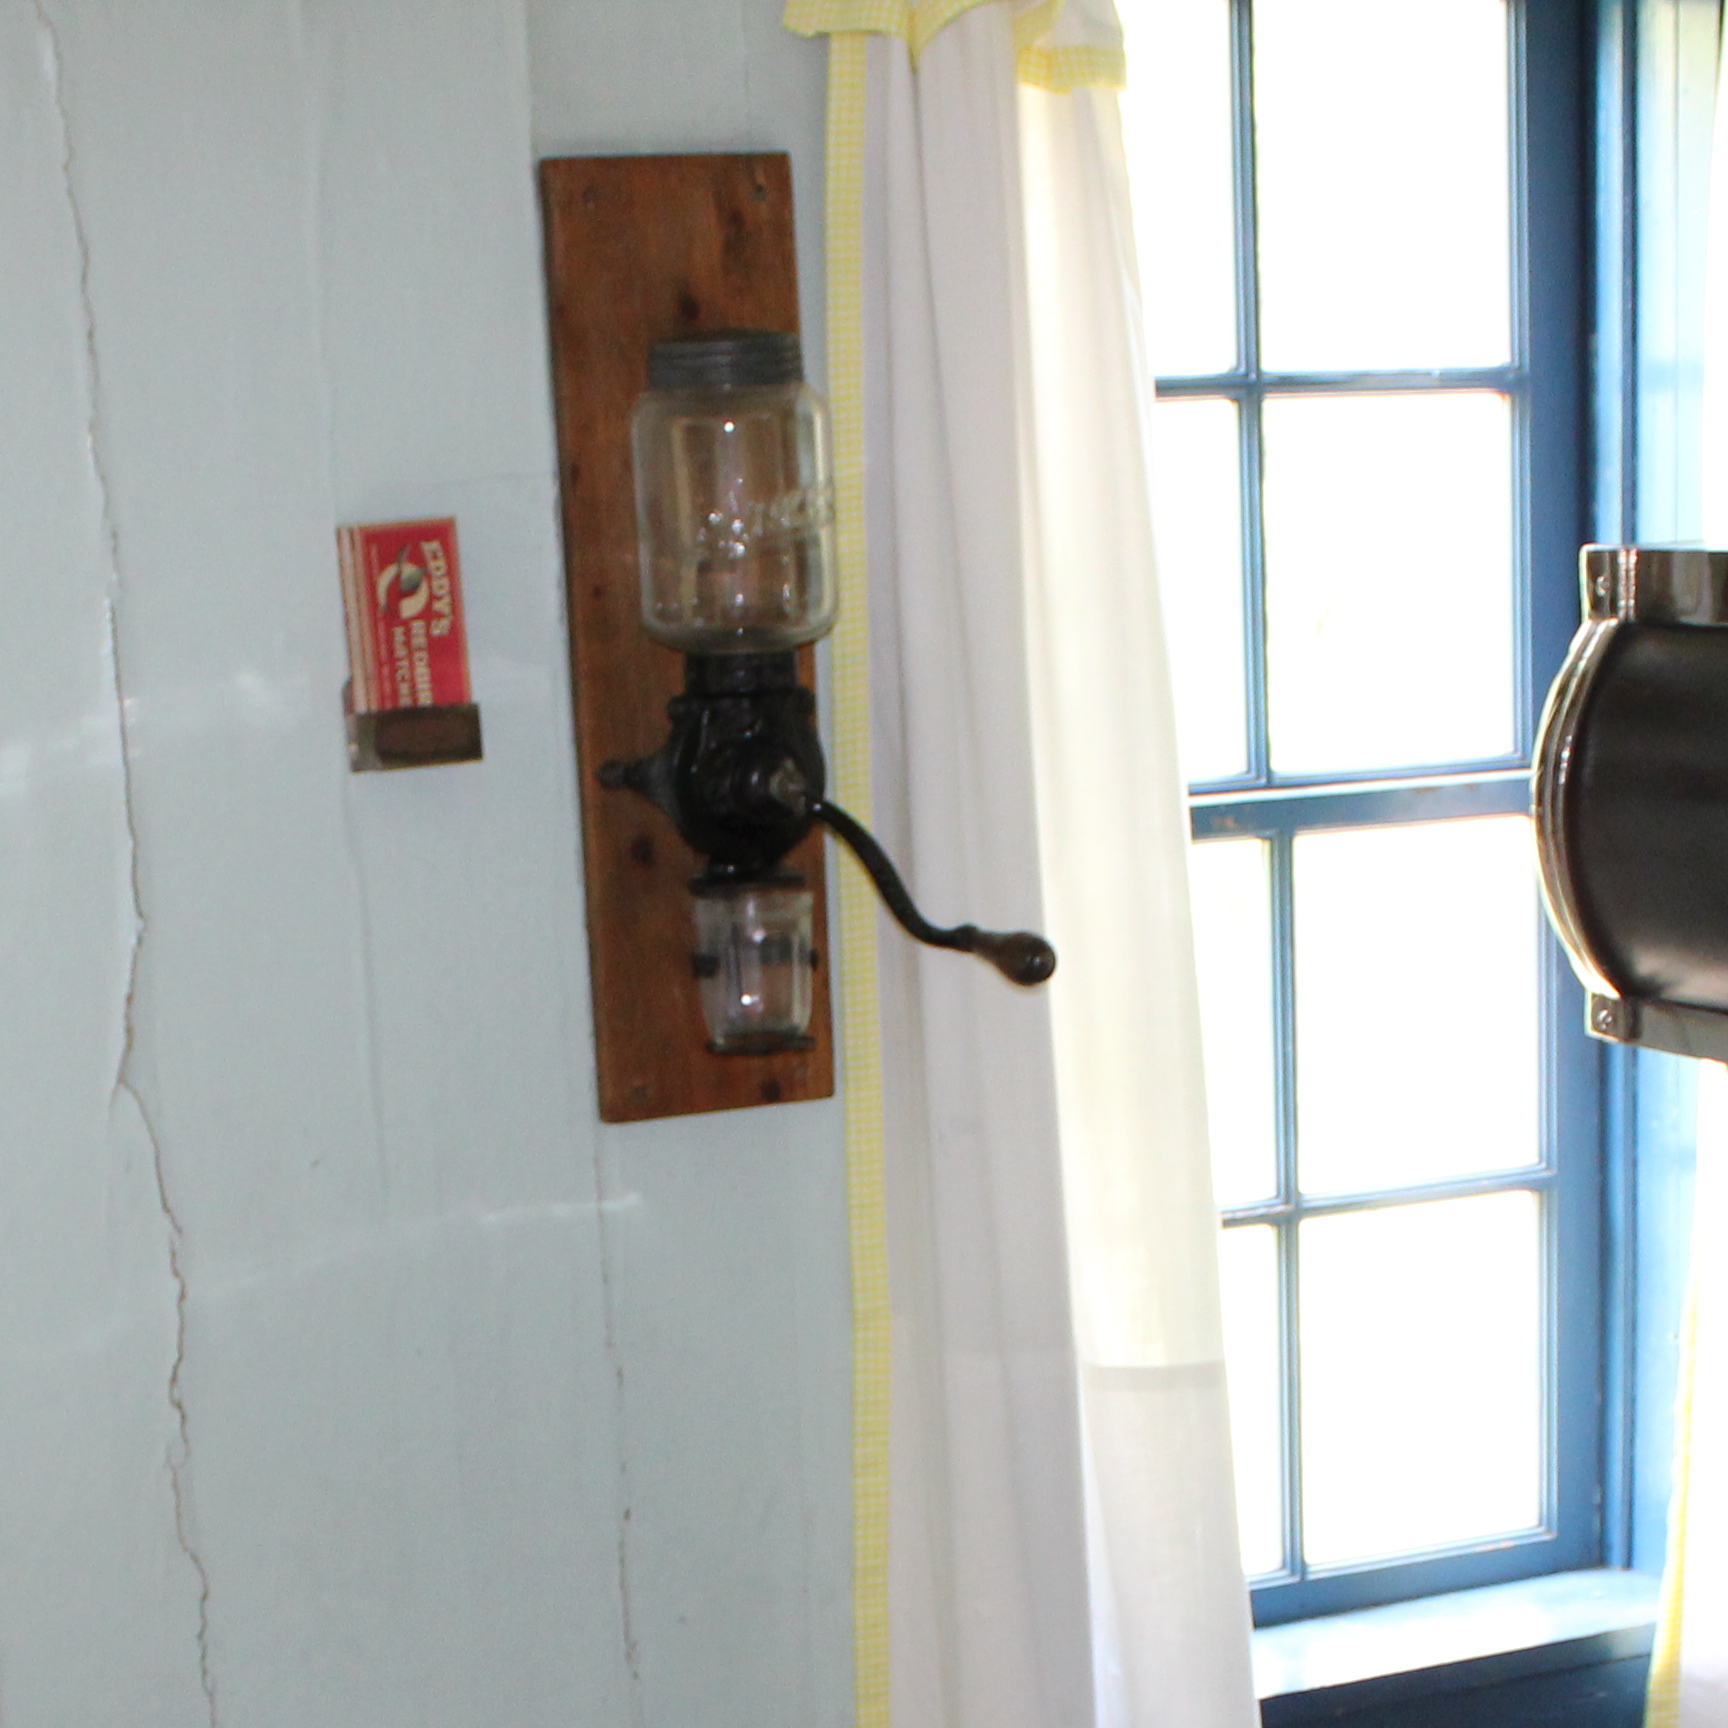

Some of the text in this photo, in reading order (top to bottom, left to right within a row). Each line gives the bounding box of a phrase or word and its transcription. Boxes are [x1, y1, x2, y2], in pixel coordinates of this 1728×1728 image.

[418, 539, 454, 637] EDDY'S
[392, 625, 414, 708] MATCHE
[410, 619, 434, 708] REDBIR
